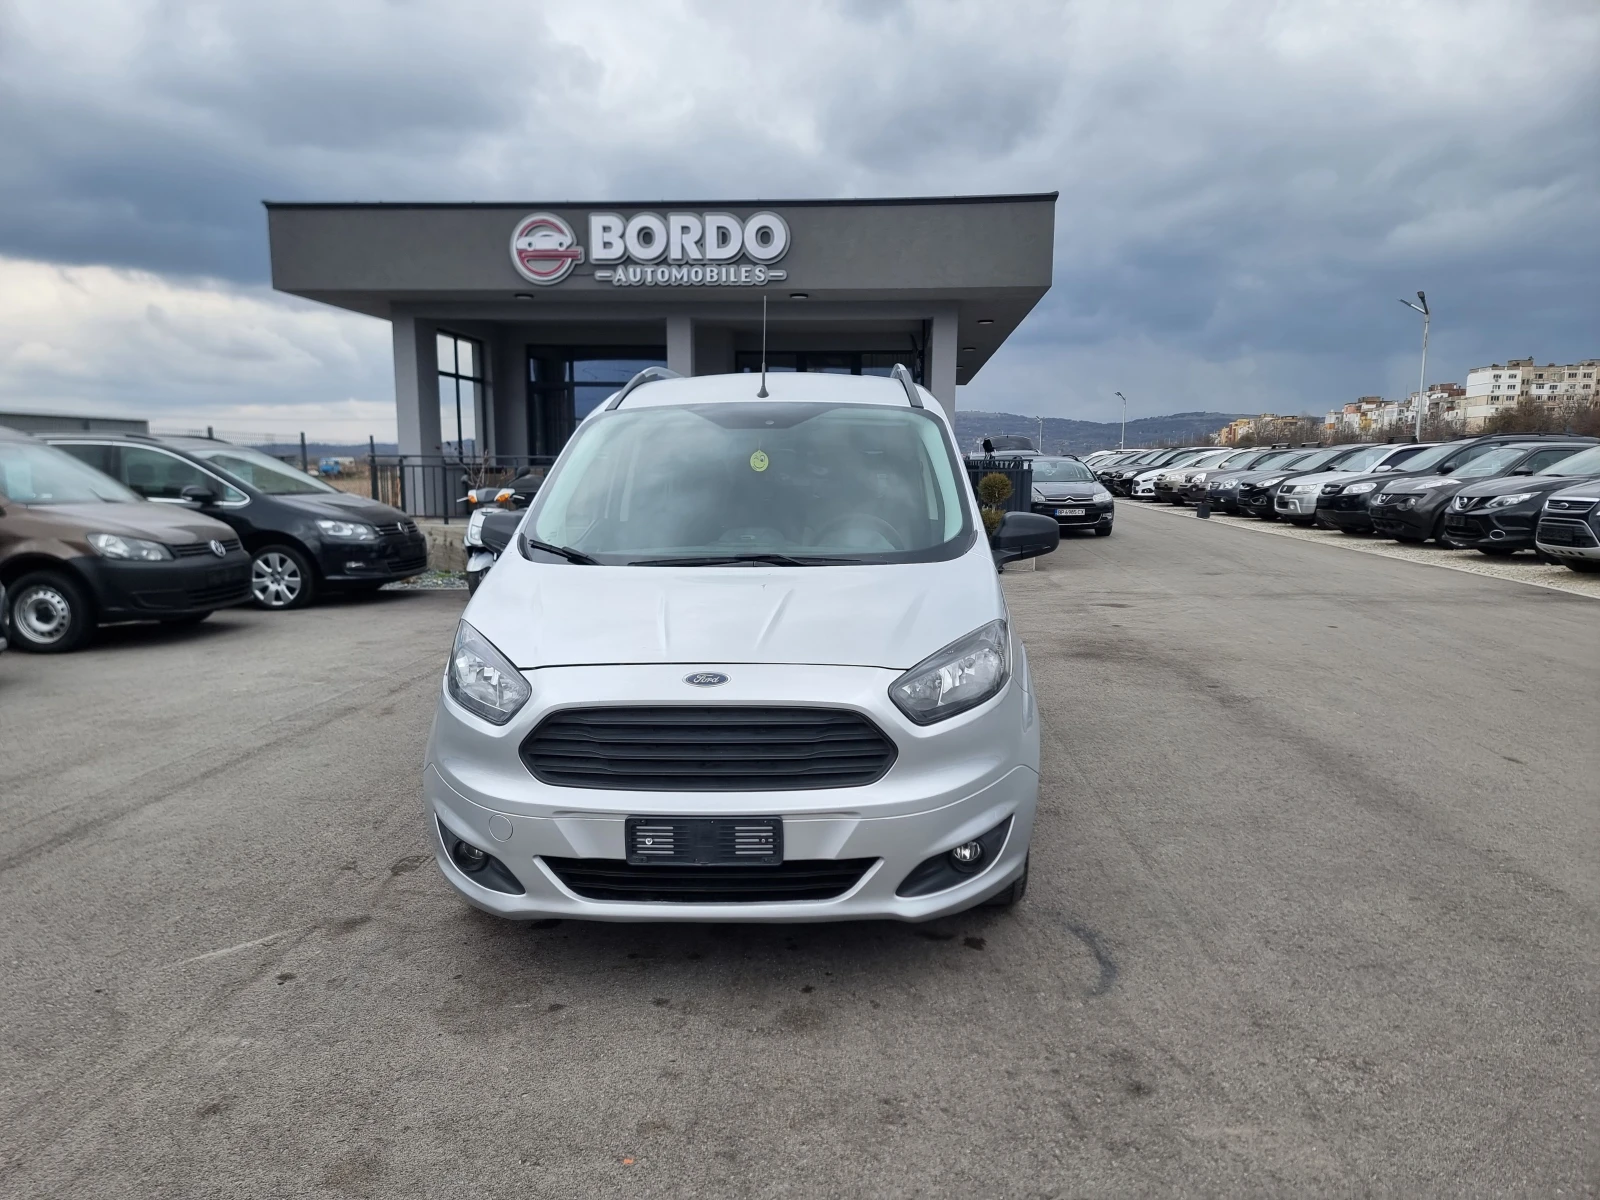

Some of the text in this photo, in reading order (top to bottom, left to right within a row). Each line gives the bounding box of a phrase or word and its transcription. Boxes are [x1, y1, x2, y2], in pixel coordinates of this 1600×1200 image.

[589, 214, 788, 261] BORDO
[614, 265, 766, 283] AUTOMOBILES
[693, 673, 720, 683] Ford
